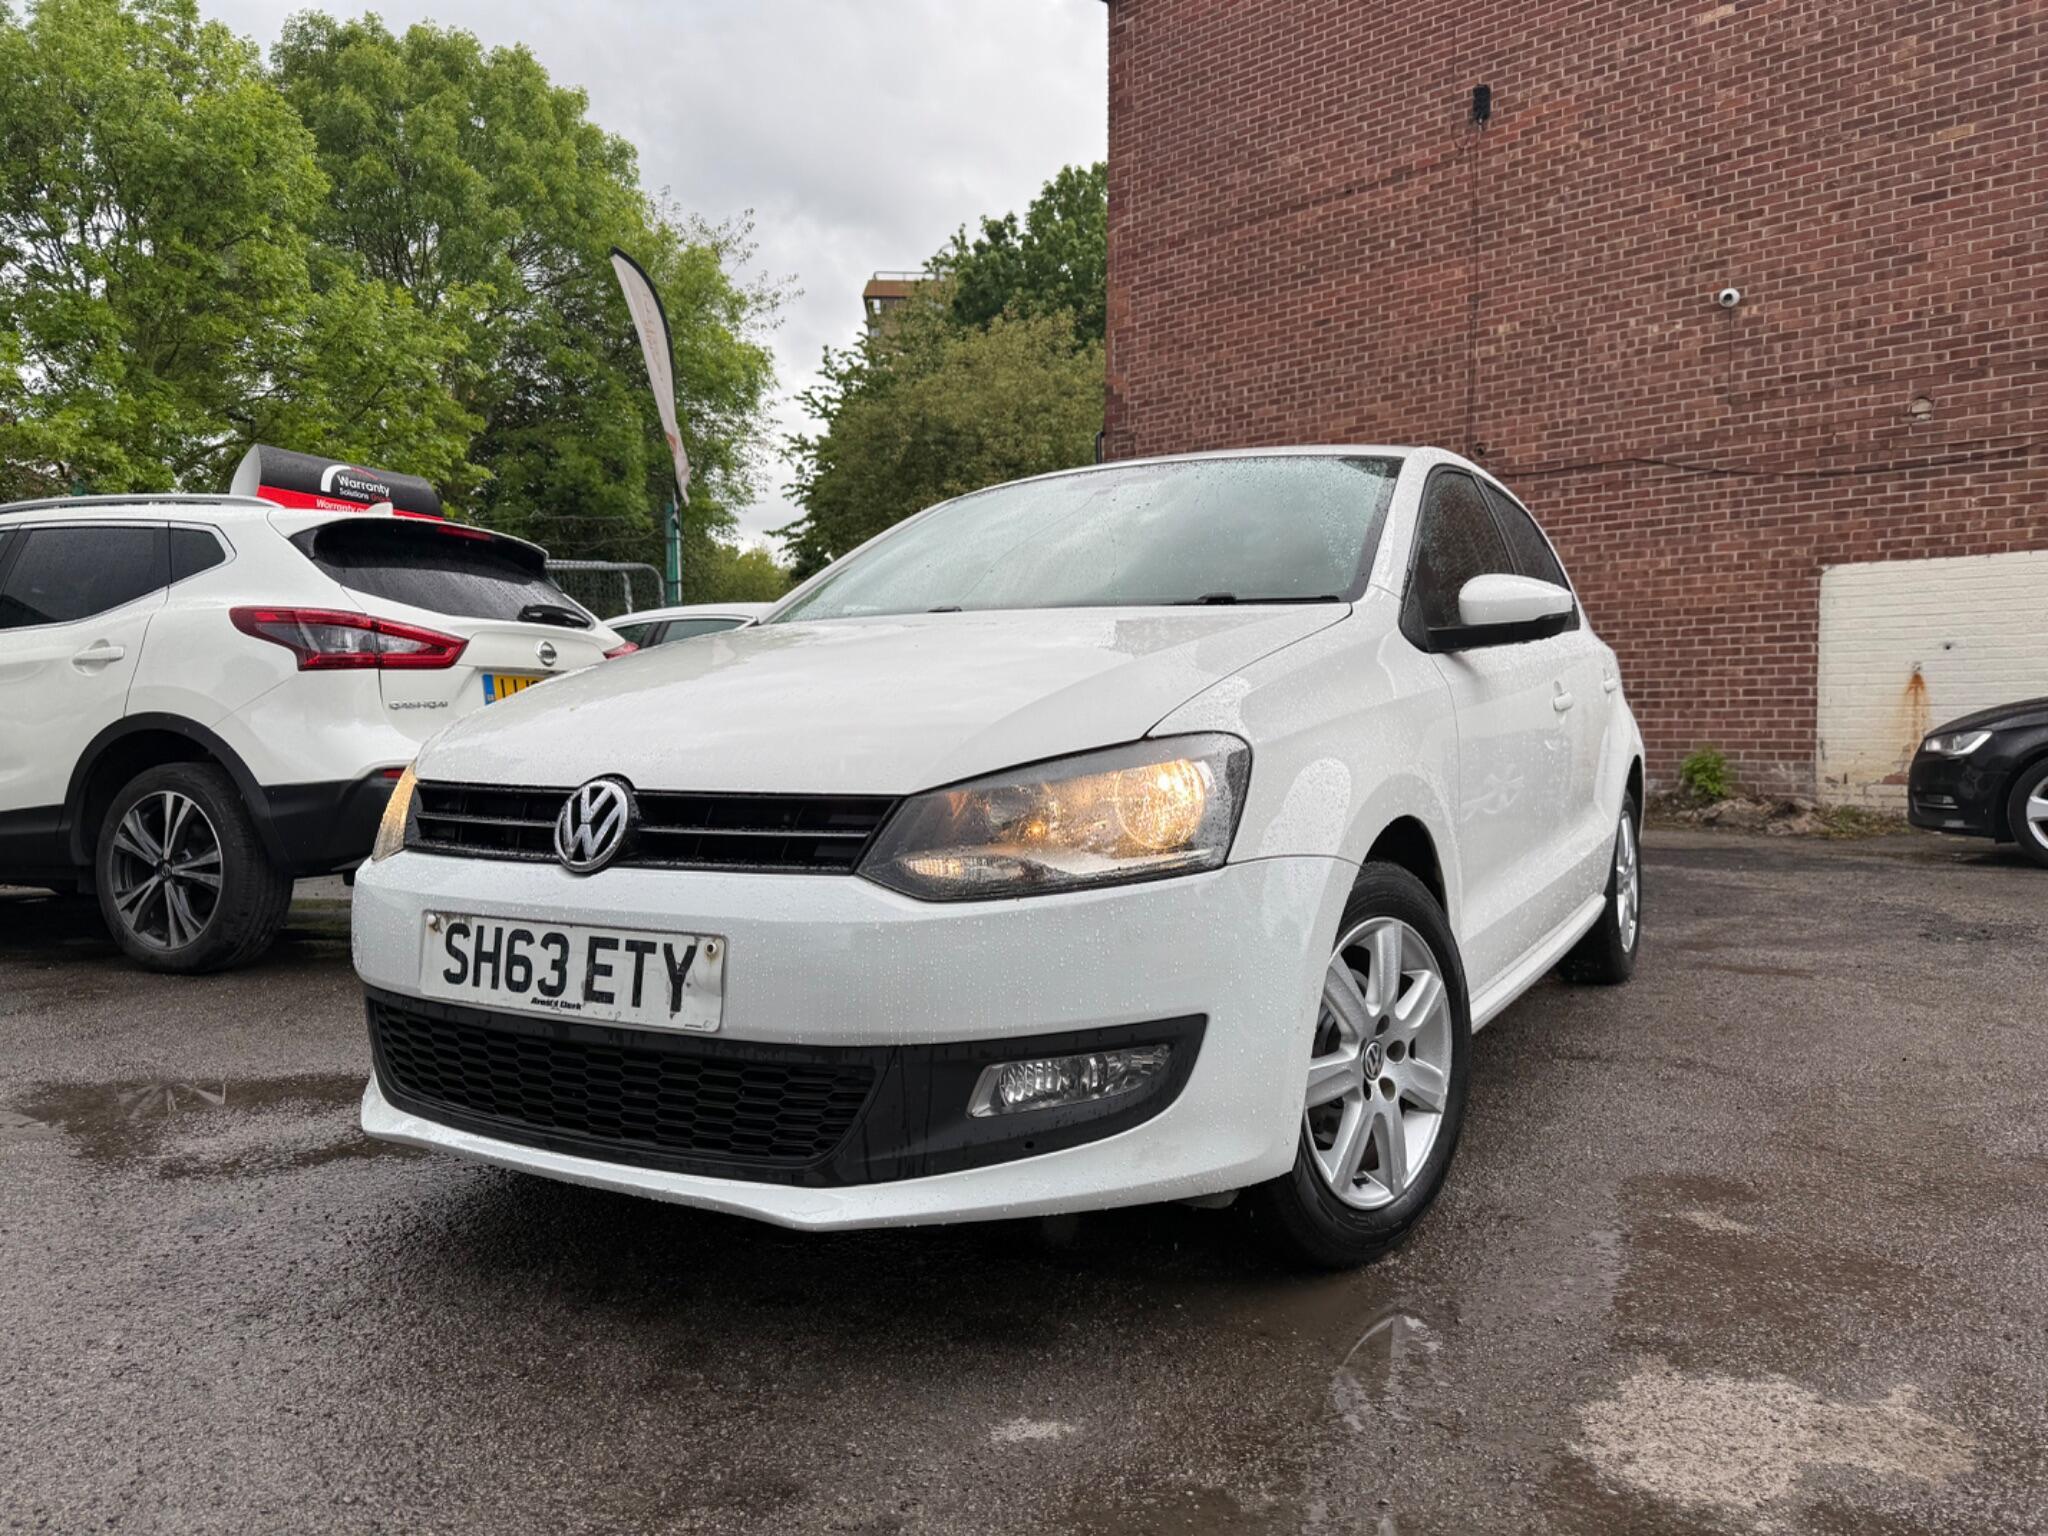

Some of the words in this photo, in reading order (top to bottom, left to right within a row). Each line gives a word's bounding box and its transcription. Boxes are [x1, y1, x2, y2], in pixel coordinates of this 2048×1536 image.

[337, 475, 389, 498] Warranty
[339, 487, 369, 499] Solutions
[443, 922, 570, 998] SH63
[583, 935, 698, 1013] ETY
